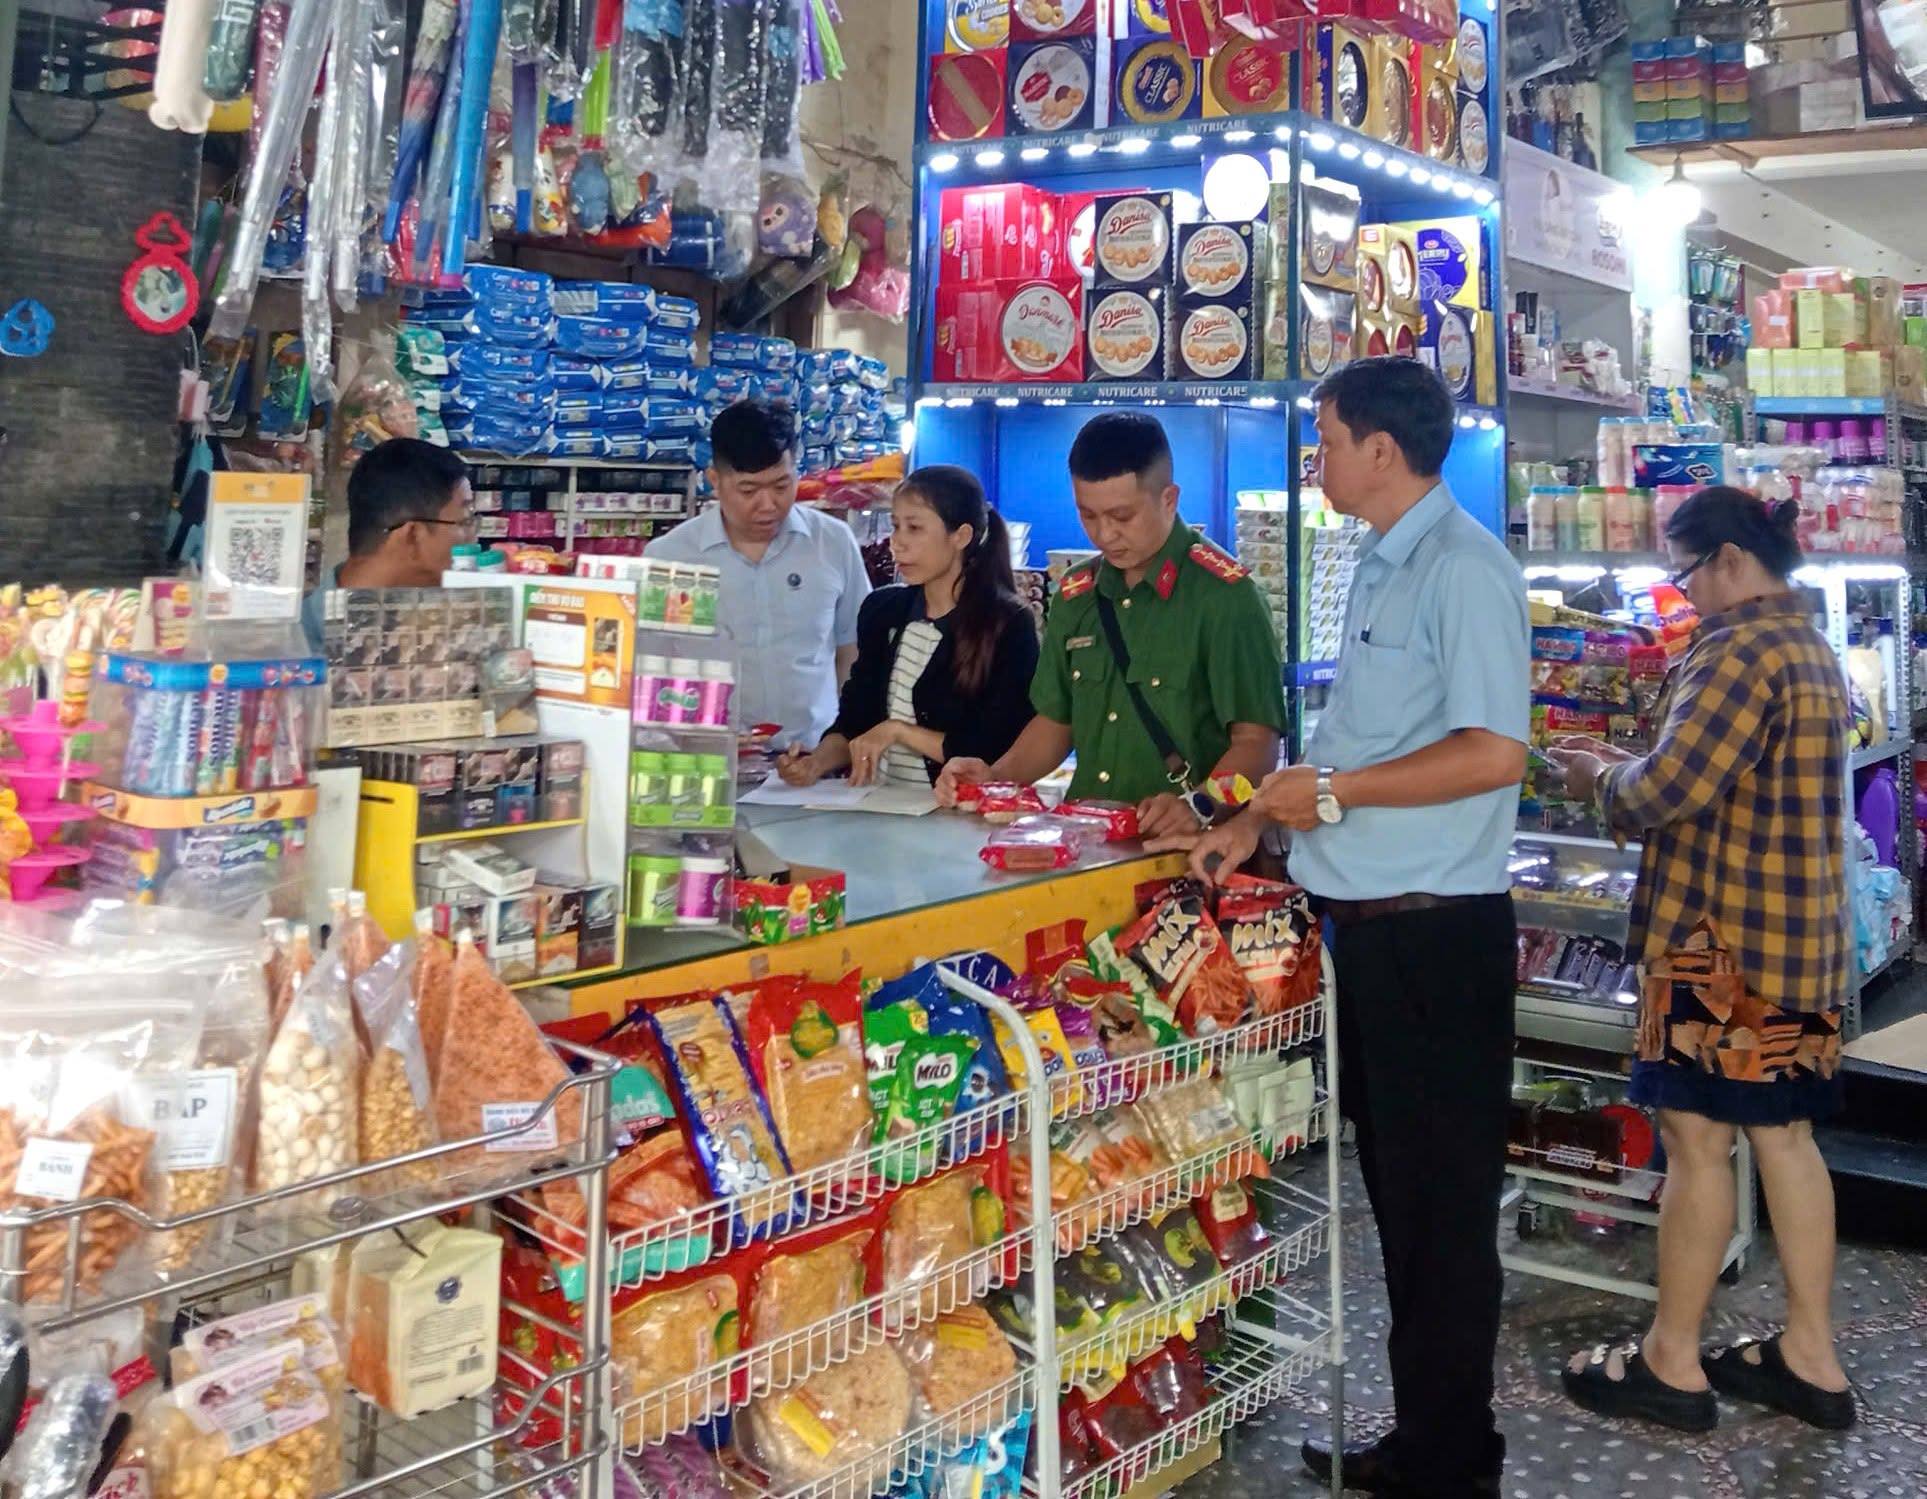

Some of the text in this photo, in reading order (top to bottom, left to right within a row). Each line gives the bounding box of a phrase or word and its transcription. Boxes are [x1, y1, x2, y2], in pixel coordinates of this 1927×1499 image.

[1187, 119, 1248, 133] NUTRICARE
[1098, 305, 1144, 329] Danisa
[1018, 387, 1073, 397] NUTRICARE
[1097, 387, 1158, 397] NUTRICARE
[1185, 386, 1248, 397] NUTRICARE
[917, 1063, 951, 1083] MILO
[610, 1092, 661, 1121] ados
